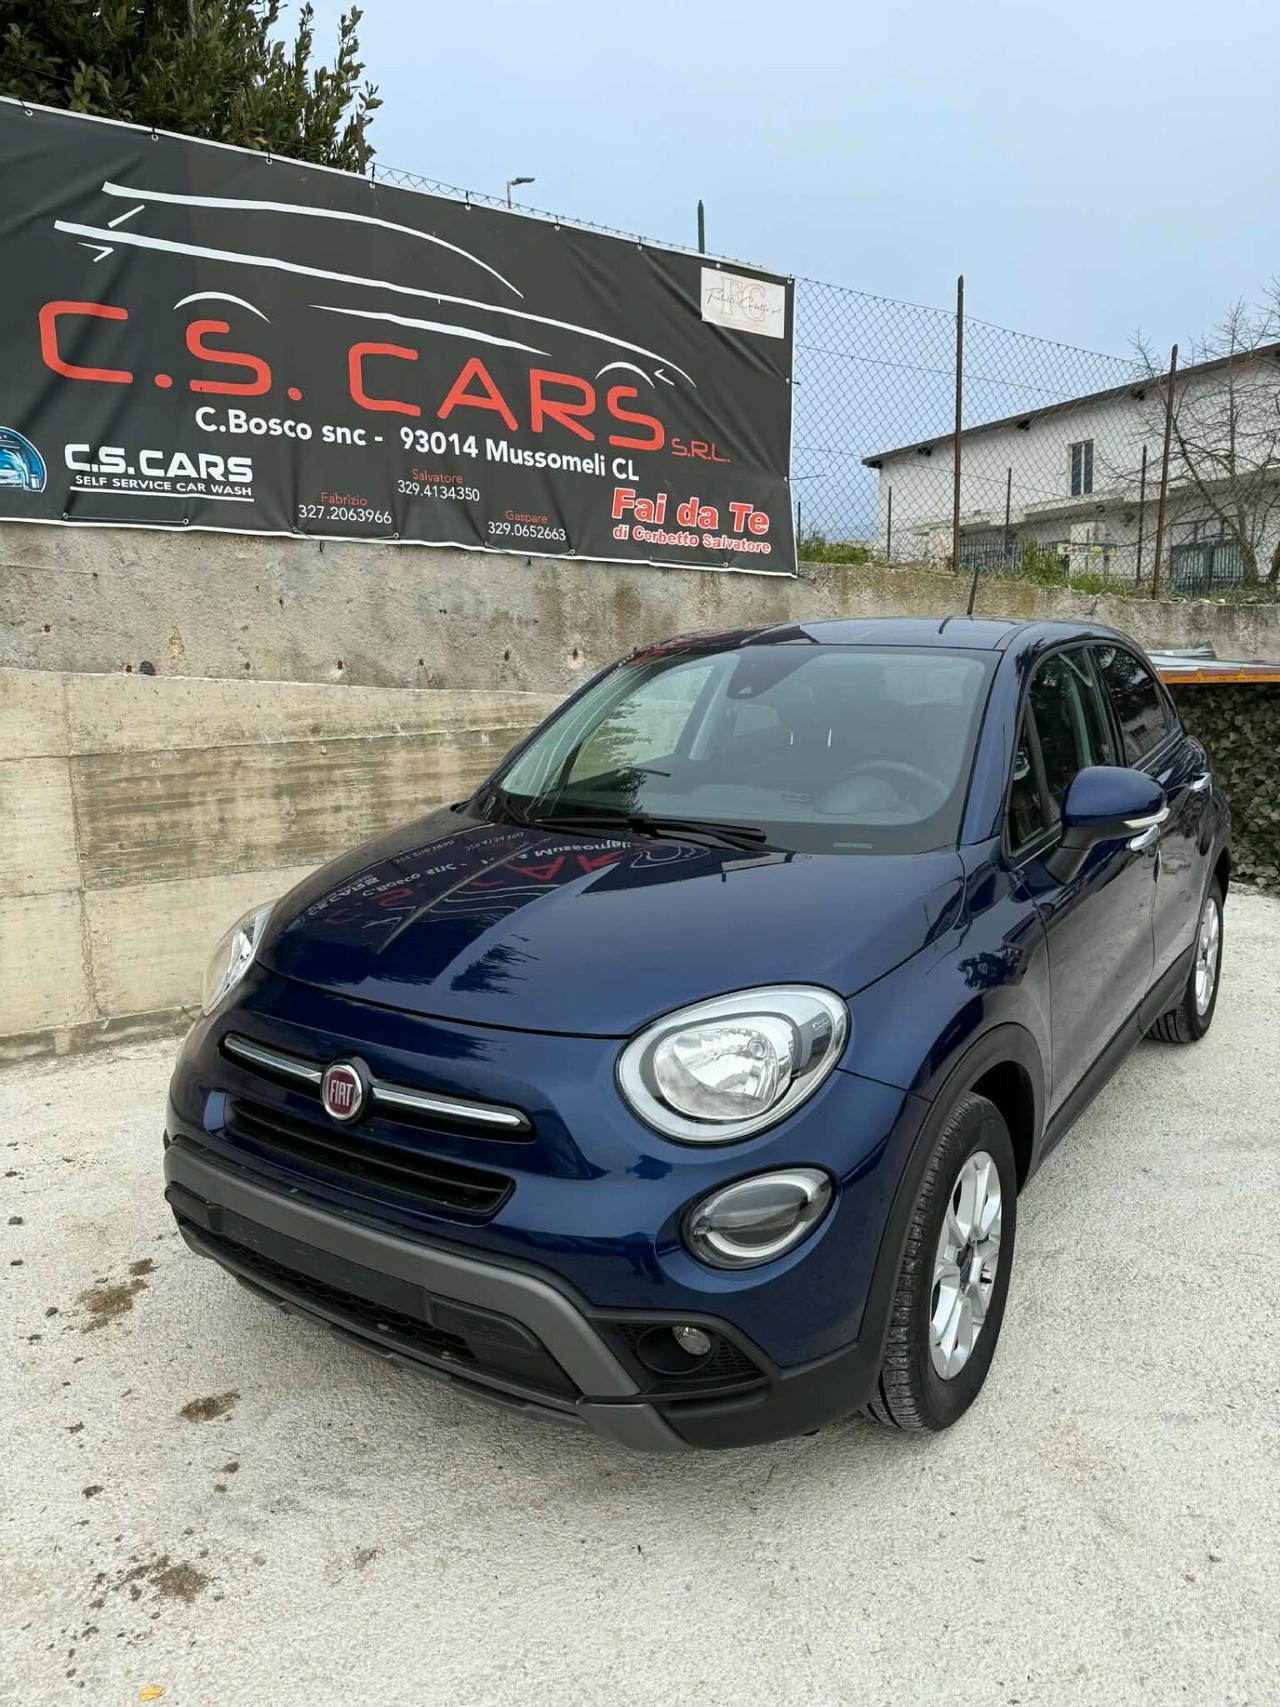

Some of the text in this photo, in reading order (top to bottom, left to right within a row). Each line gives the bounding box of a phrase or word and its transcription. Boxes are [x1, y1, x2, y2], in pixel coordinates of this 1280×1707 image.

[348, 342, 665, 451] CARS
[195, 406, 313, 440] C.Bosco
[321, 425, 367, 446] snc
[400, 426, 479, 458] 93014
[486, 438, 606, 477] Mussomeli
[611, 457, 640, 481] CL
[75, 475, 252, 496] SELF SERVICE CAR WASH
[412, 468, 464, 484] Salvatore
[320, 491, 368, 506] Fabrizio
[397, 480, 480, 502] 329.4134350
[298, 504, 392, 525] 327.2063966
[505, 509, 548, 524] Gaspare
[611, 487, 770, 535] Fai da Te
[487, 521, 566, 541] 329.0652663
[612, 524, 772, 554] di Corbetto Salvatore
[330, 1079, 354, 1107] FIAT
